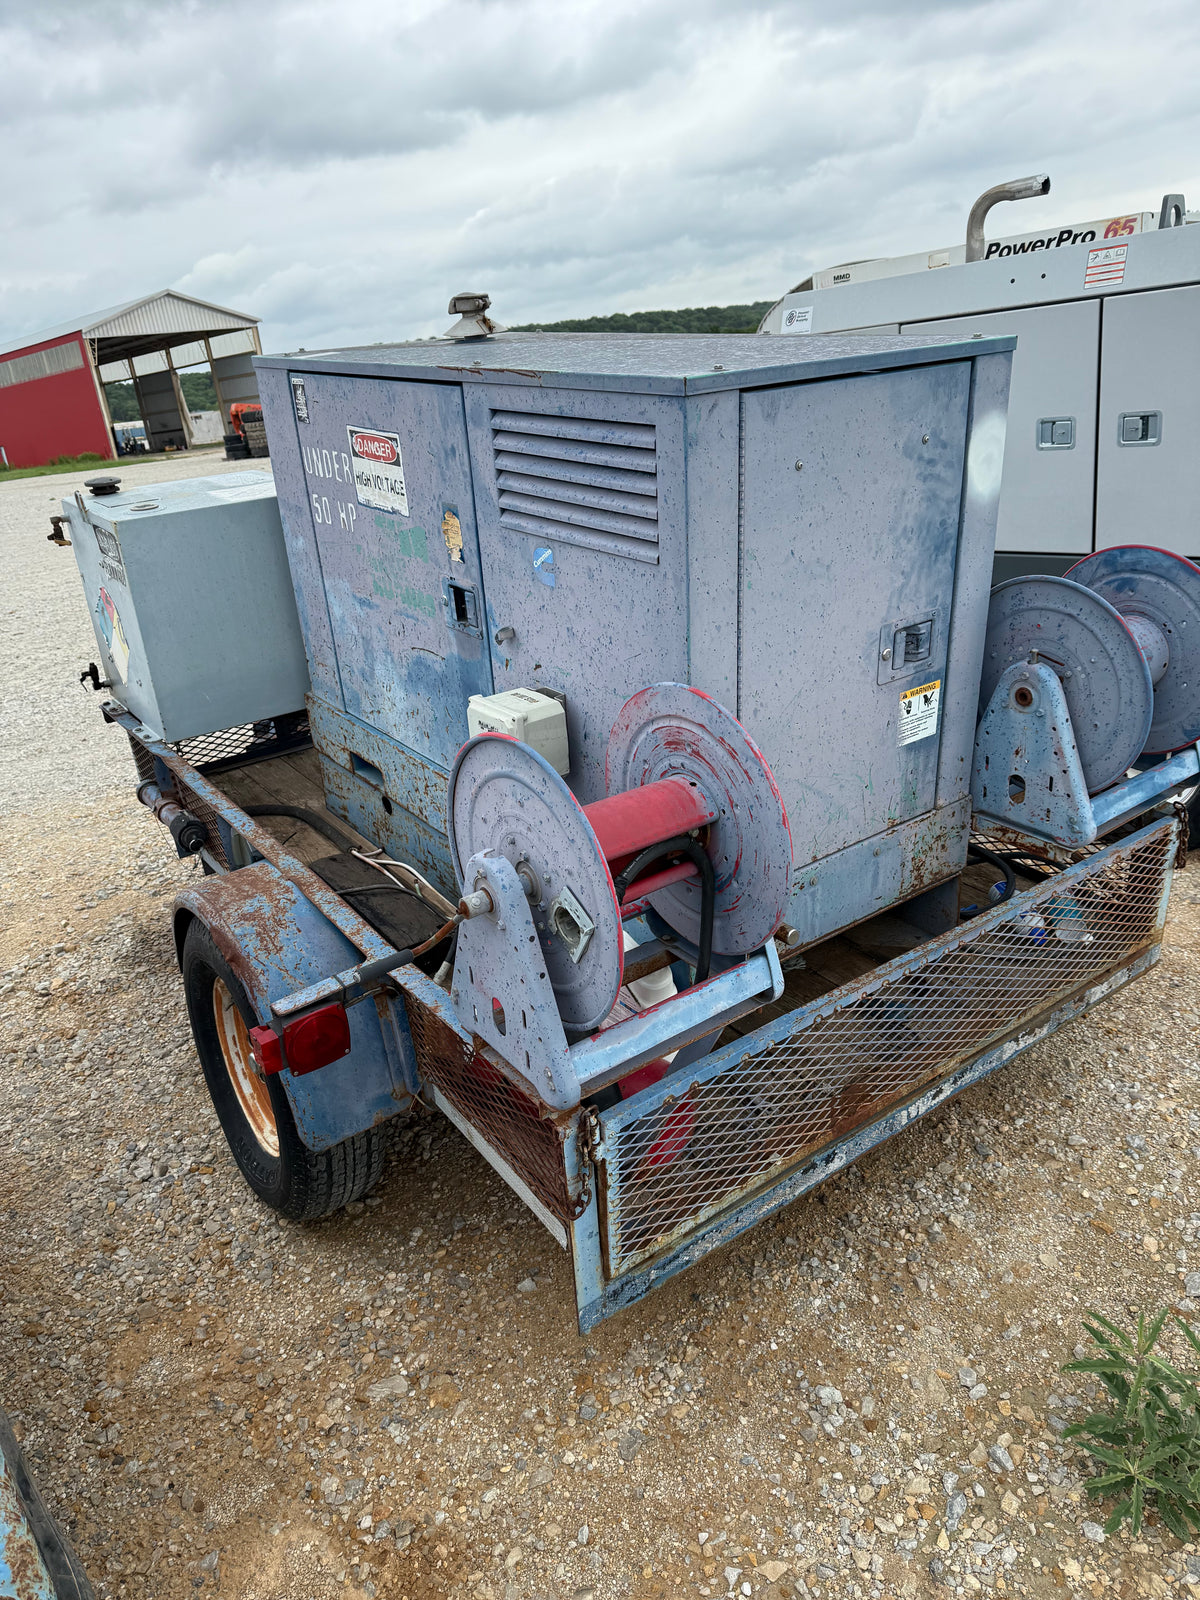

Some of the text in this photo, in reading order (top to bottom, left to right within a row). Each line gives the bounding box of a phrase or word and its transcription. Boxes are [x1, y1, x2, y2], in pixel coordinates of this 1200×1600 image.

[985, 217, 1138, 260] PowerPro 65
[833, 273, 851, 281] MMD
[358, 438, 392, 458] DANGER
[303, 446, 354, 484] UNDER
[356, 471, 372, 488] HIGH
[312, 493, 356, 532] 50 HP
[533, 549, 552, 568] Cummins
[910, 683, 937, 697] WARNING
